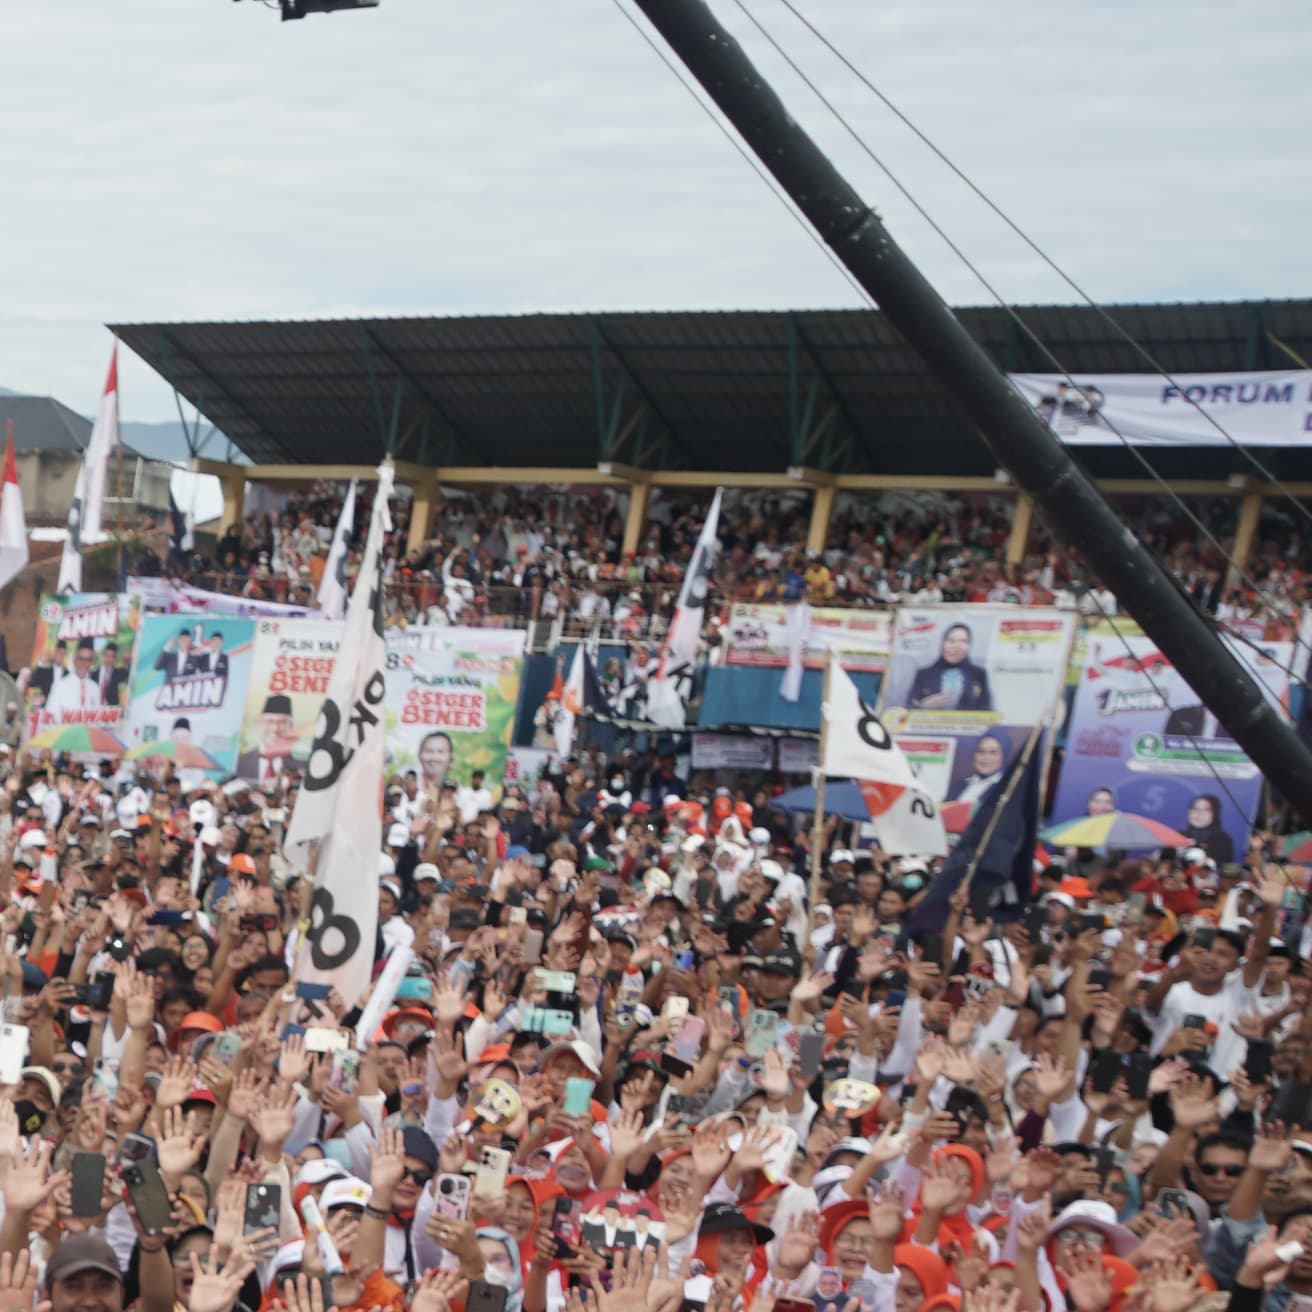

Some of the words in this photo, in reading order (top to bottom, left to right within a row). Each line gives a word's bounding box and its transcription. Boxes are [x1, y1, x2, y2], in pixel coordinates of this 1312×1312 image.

[1160, 383, 1294, 405] FORUM
[57, 604, 120, 640] AMIN
[155, 675, 226, 711] AMIN
[420, 691, 483, 708] SEGER
[305, 886, 361, 971] 8
